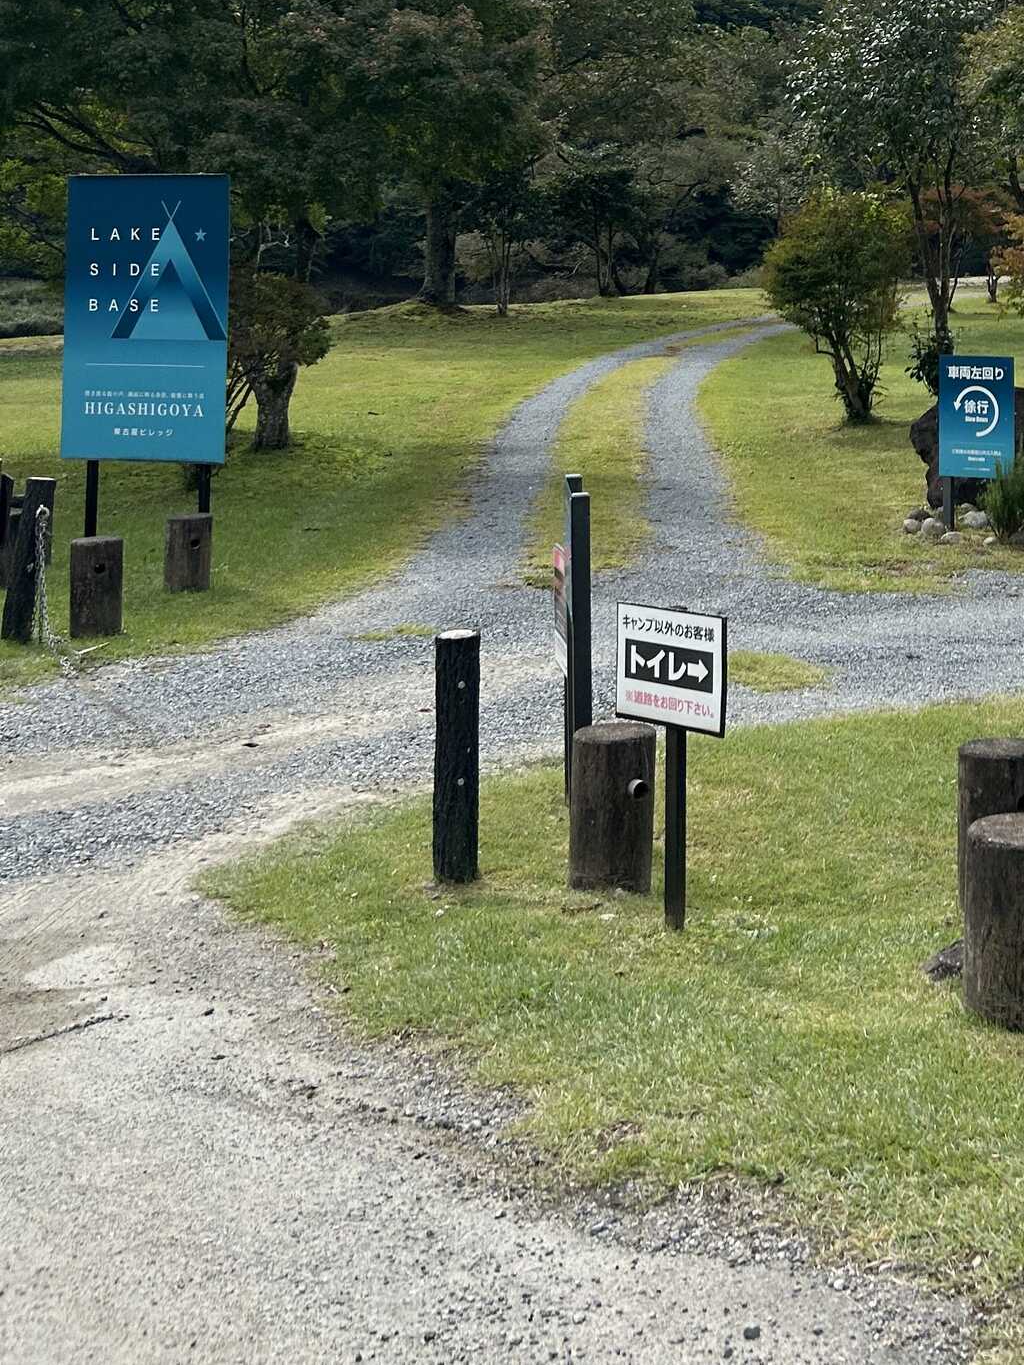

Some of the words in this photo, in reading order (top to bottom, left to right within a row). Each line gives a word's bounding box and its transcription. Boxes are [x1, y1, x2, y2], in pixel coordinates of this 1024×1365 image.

[91, 227, 161, 242] LAKE
[89, 263, 160, 277] SIDE
[88, 299, 160, 312] BASE
[84, 401, 204, 418] HIGASHIGOYA
[964, 399, 989, 414] 徐行
[622, 613, 715, 643] キャンプ以外のお客様
[630, 644, 687, 681] トイレ
